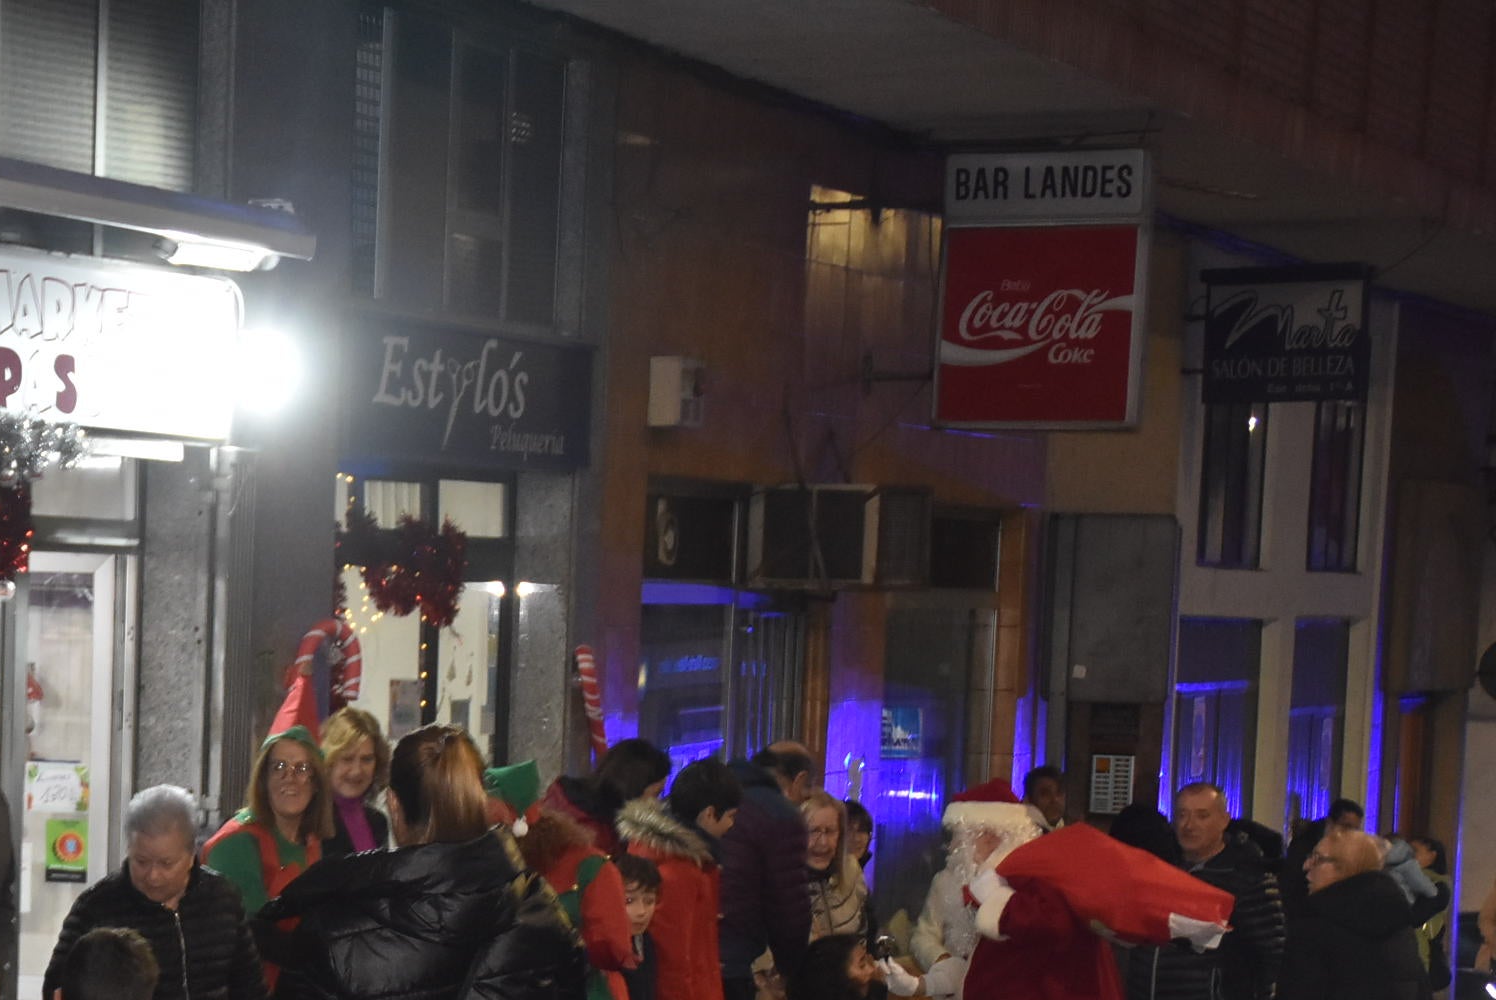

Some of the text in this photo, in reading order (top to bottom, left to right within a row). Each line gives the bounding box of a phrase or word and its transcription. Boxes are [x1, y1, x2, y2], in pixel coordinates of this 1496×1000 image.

[955, 163, 1134, 201] BAR LANDES
[958, 288, 1109, 342] Coca-Cola
[1210, 288, 1355, 351] Marta
[1047, 342, 1096, 364] Coke
[1267, 356, 1289, 378] DE
[1292, 354, 1354, 378] BELLEZA
